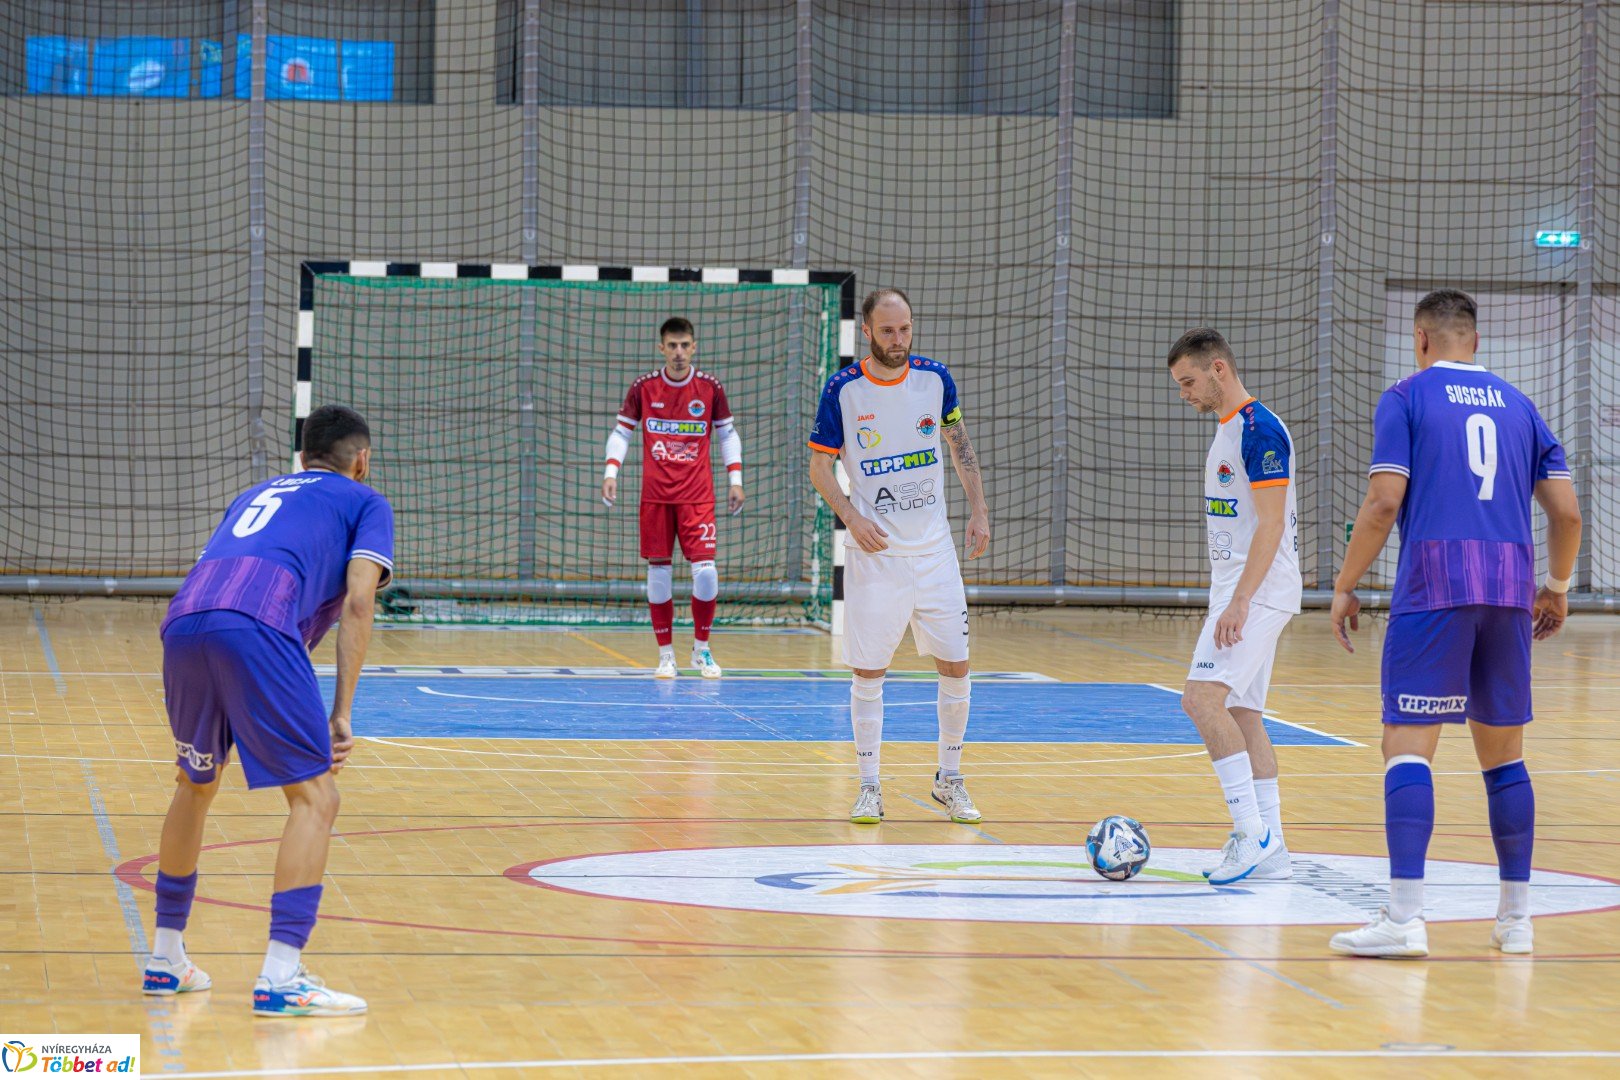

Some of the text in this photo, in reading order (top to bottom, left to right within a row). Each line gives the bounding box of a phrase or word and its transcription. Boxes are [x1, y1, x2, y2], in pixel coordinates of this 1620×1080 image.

[1445, 385, 1506, 408] SUSCSÁK
[857, 414, 875, 422] JAKO
[1465, 413, 1498, 500] 9
[232, 485, 301, 538] 5
[875, 494, 936, 515] STUDIO
[699, 523, 716, 541] 22
